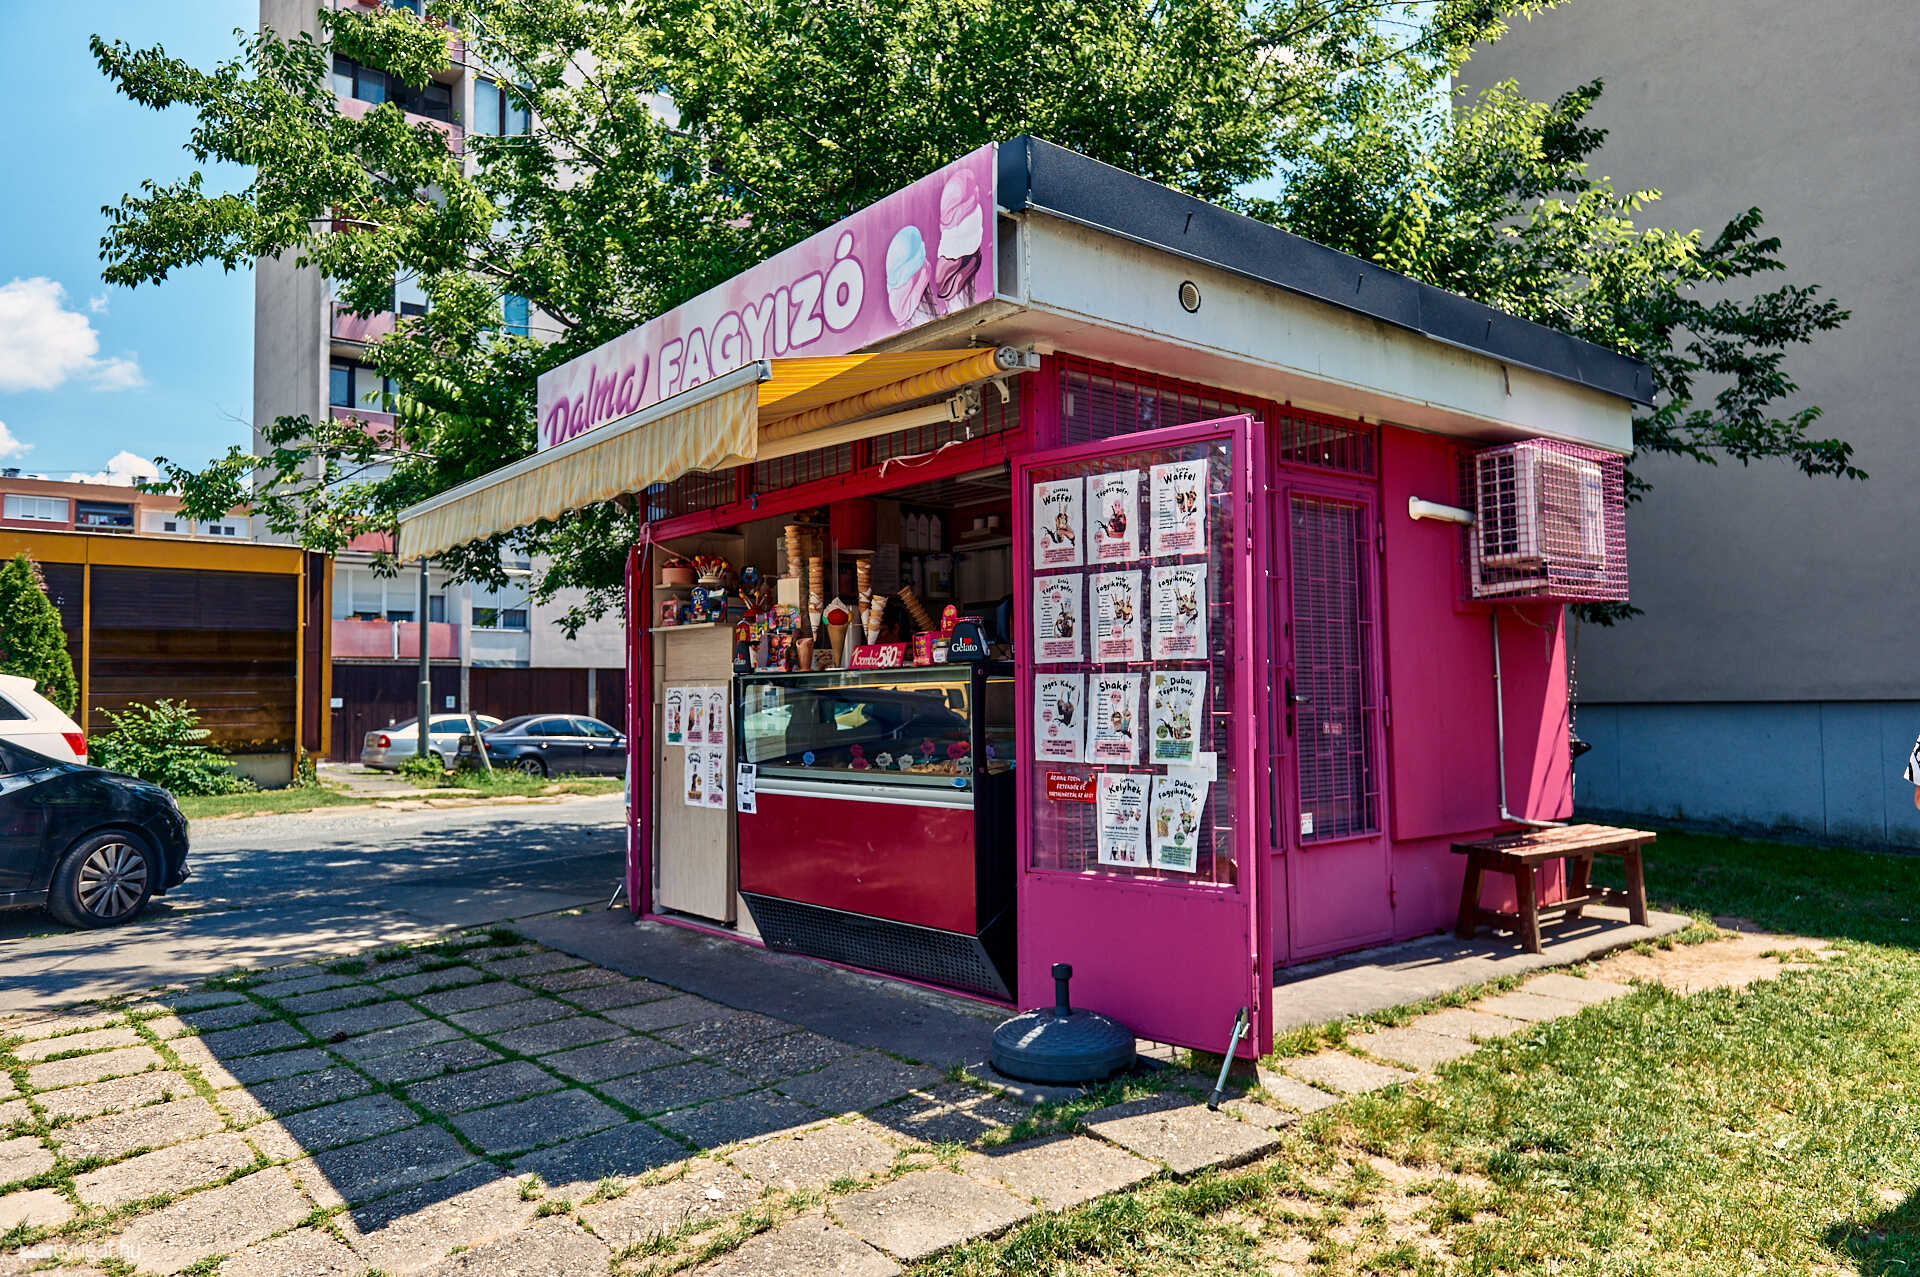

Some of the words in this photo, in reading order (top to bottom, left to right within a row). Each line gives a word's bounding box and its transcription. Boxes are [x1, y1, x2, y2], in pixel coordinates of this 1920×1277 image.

[545, 354, 649, 446] Dalma
[658, 230, 864, 401] FAGYIZÓ
[1163, 472, 1196, 485] Waffel
[1042, 493, 1072, 506] Waffel
[951, 643, 978, 652] Gelato
[878, 645, 898, 667] 580
[1042, 680, 1058, 692] Jeges
[1170, 676, 1192, 686] Dubai
[1109, 783, 1142, 795] Kelyhek
[1174, 779, 1193, 790] Dubai
